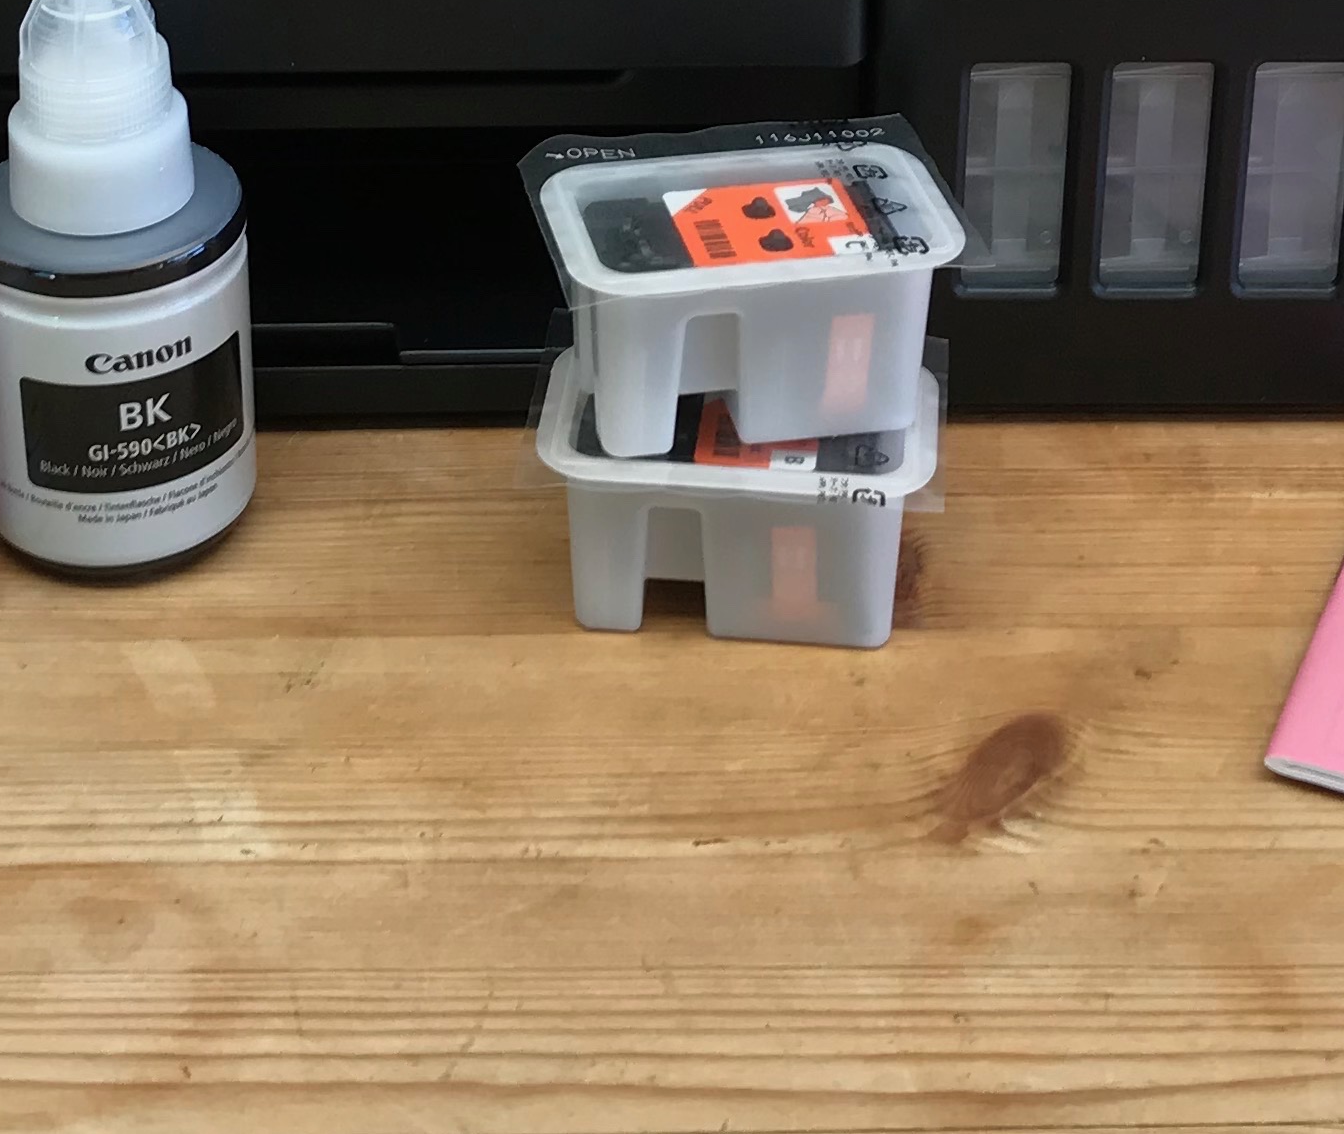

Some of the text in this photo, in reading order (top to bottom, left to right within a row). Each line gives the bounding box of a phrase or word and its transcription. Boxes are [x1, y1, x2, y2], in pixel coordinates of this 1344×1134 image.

[566, 145, 636, 161] OPEN
[85, 335, 193, 375] Canon
[119, 392, 173, 432] BK
[40, 458, 71, 477] Black
[81, 464, 109, 478] Noir
[119, 453, 171, 477] Schwarz
[179, 441, 206, 460] Nero
[88, 422, 202, 462] GI-590<BK>
[78, 512, 103, 523] Made
[105, 513, 114, 523] in
[116, 511, 142, 524] Japan
